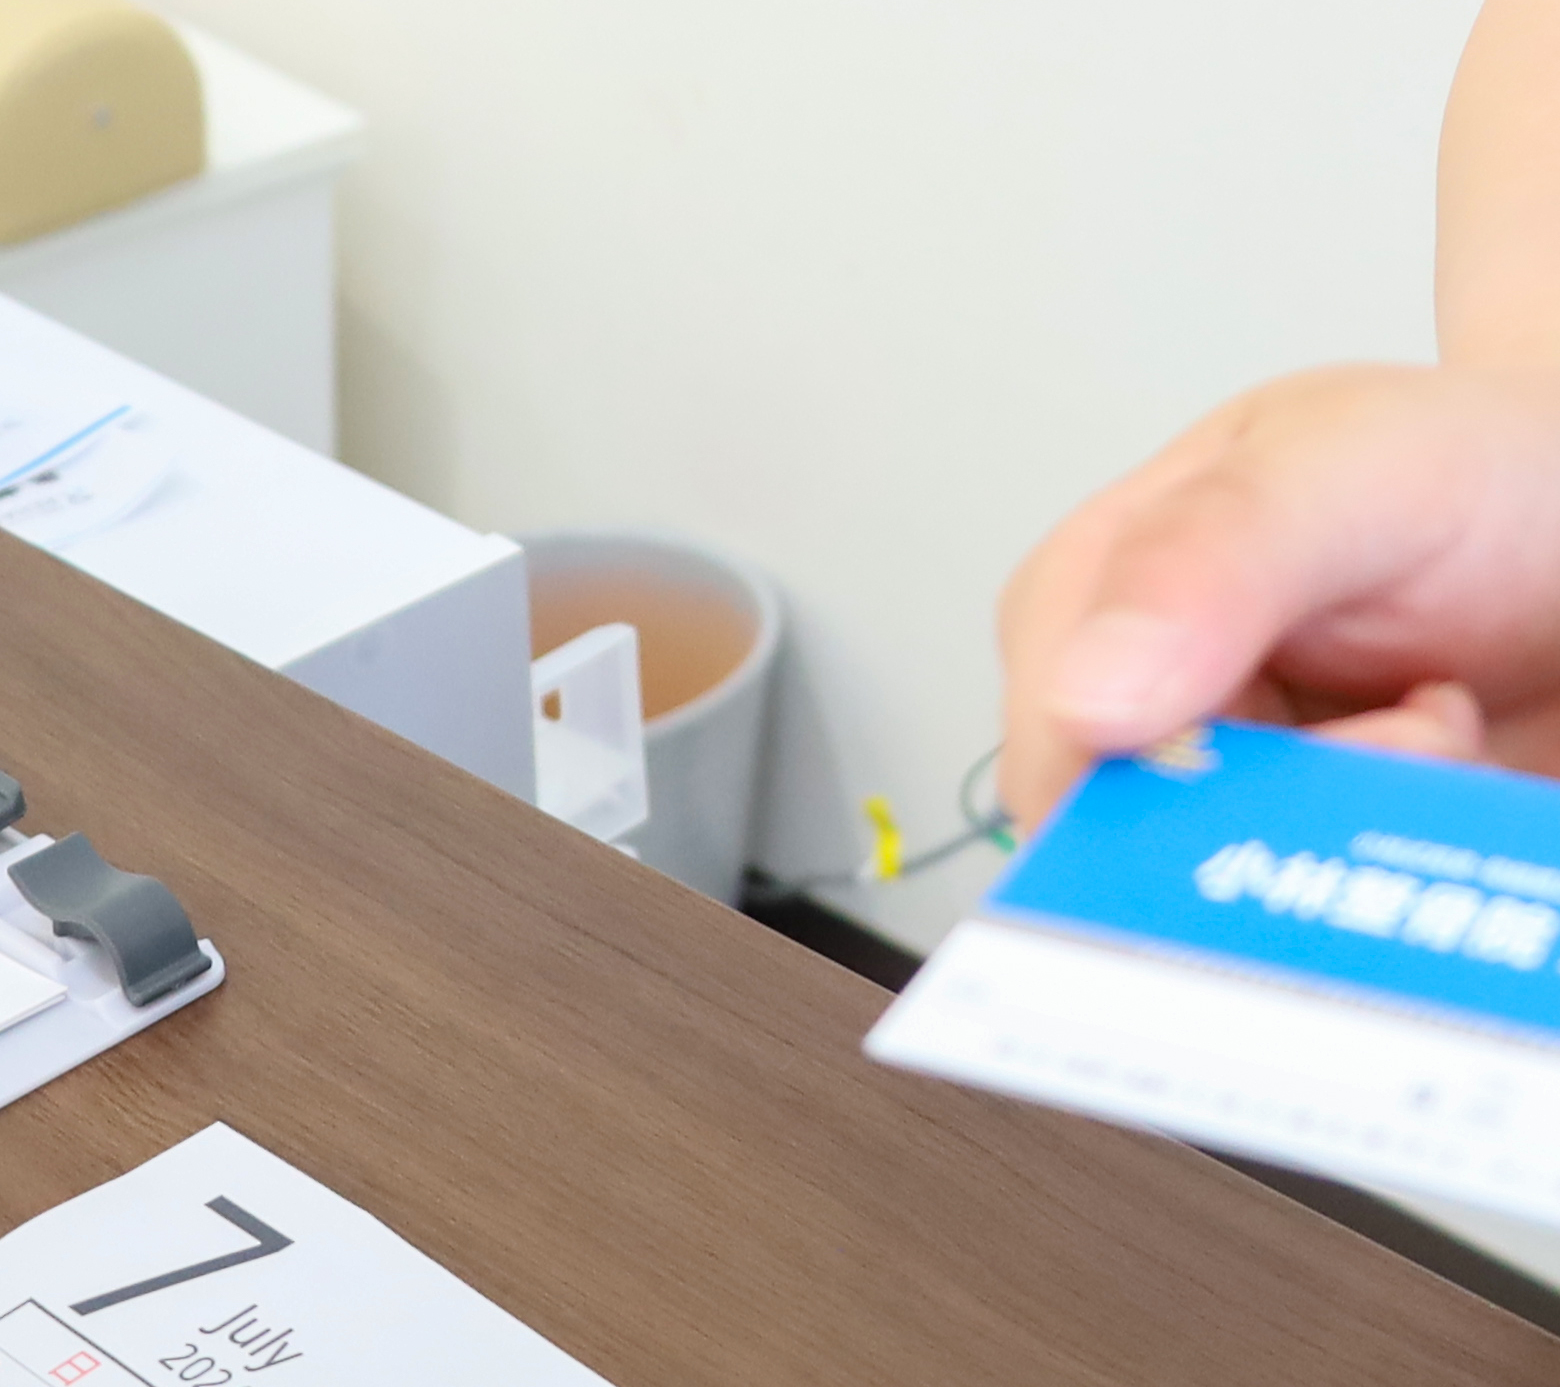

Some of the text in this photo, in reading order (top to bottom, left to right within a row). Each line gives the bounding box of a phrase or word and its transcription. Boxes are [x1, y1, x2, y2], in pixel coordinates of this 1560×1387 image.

[69, 1194, 295, 1317] 7
[158, 1342, 252, 1387] 202
[198, 1303, 304, 1373] July
[47, 1350, 102, 1386] 日
